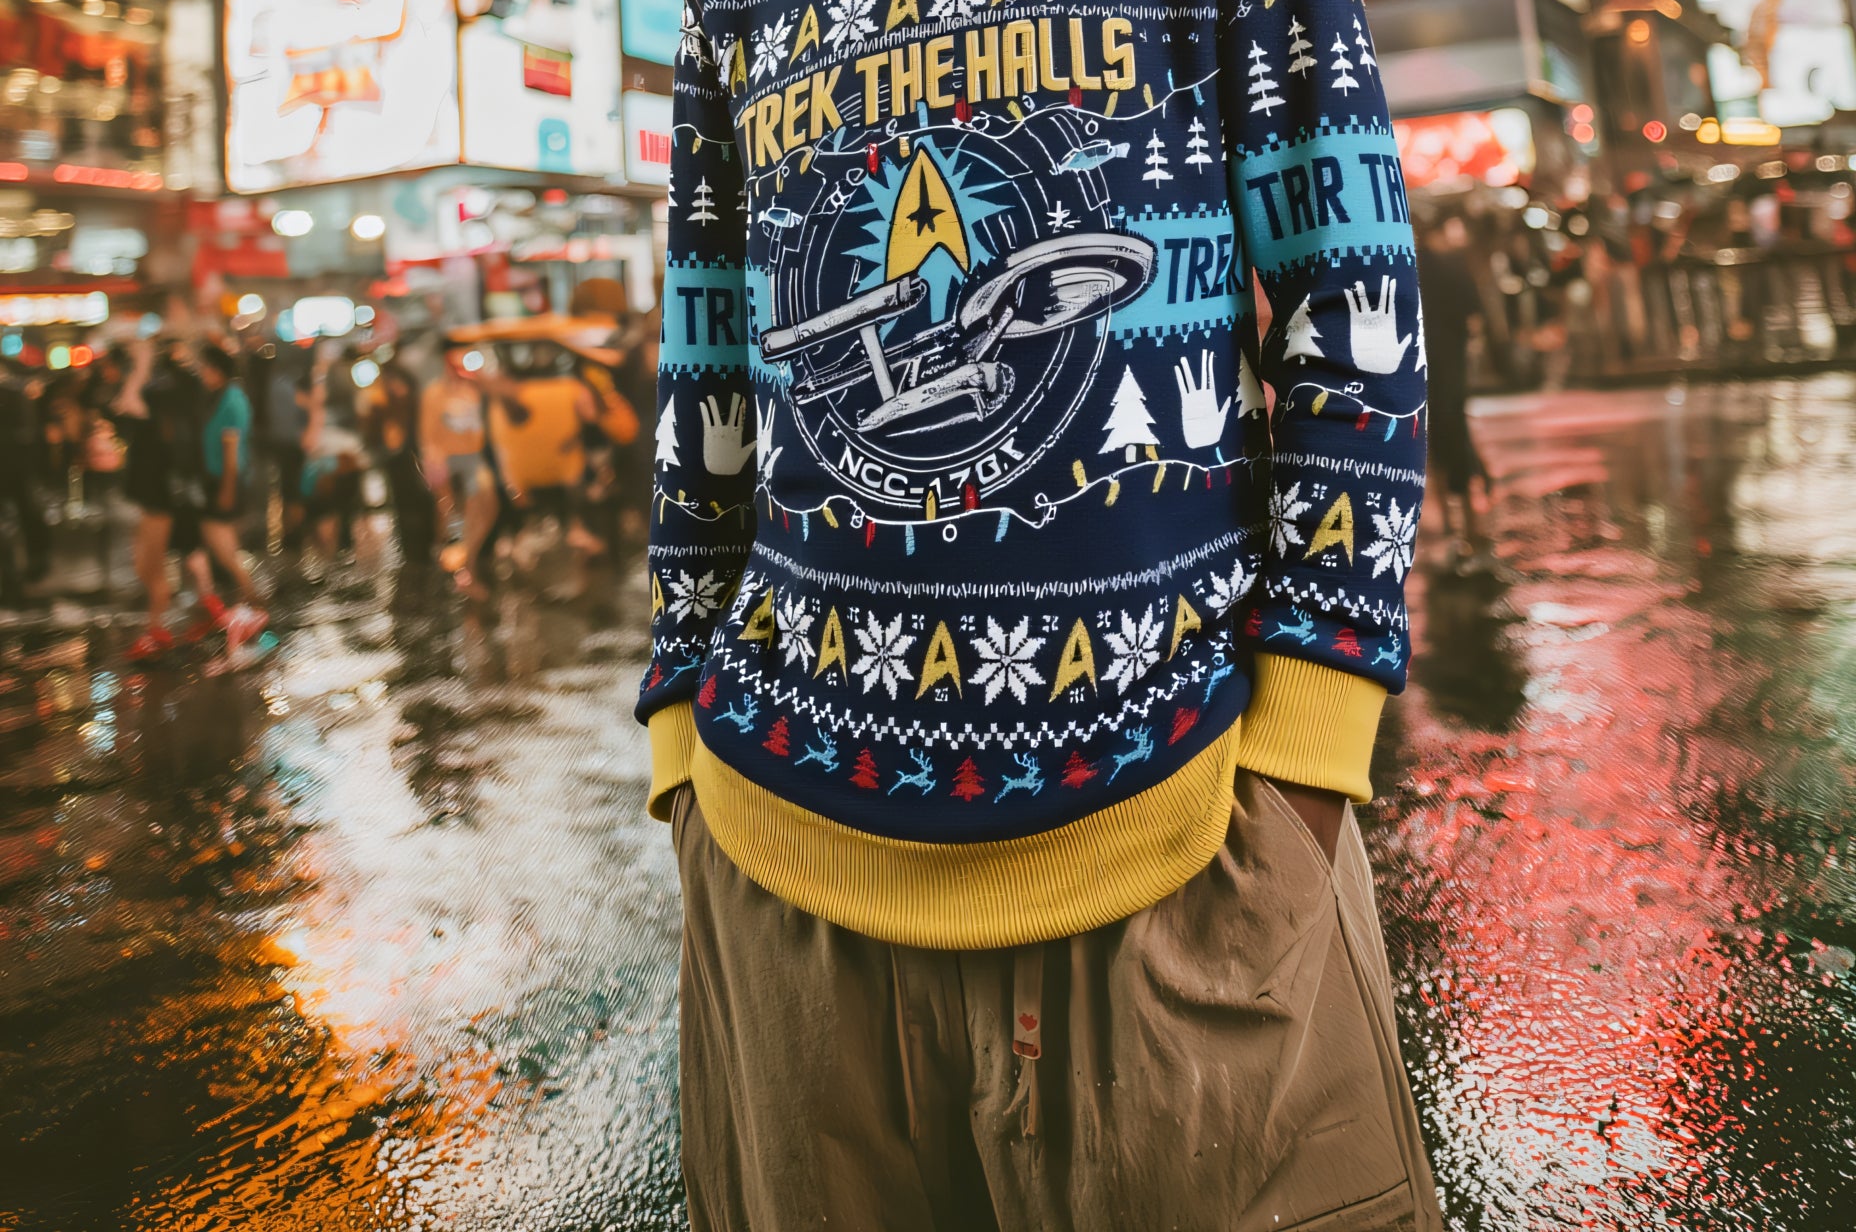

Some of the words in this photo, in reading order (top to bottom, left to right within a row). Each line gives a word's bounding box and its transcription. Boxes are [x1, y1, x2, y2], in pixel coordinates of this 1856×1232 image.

[735, 65, 843, 167] TREK
[856, 34, 957, 125] THE
[965, 17, 1135, 104] HALLS
